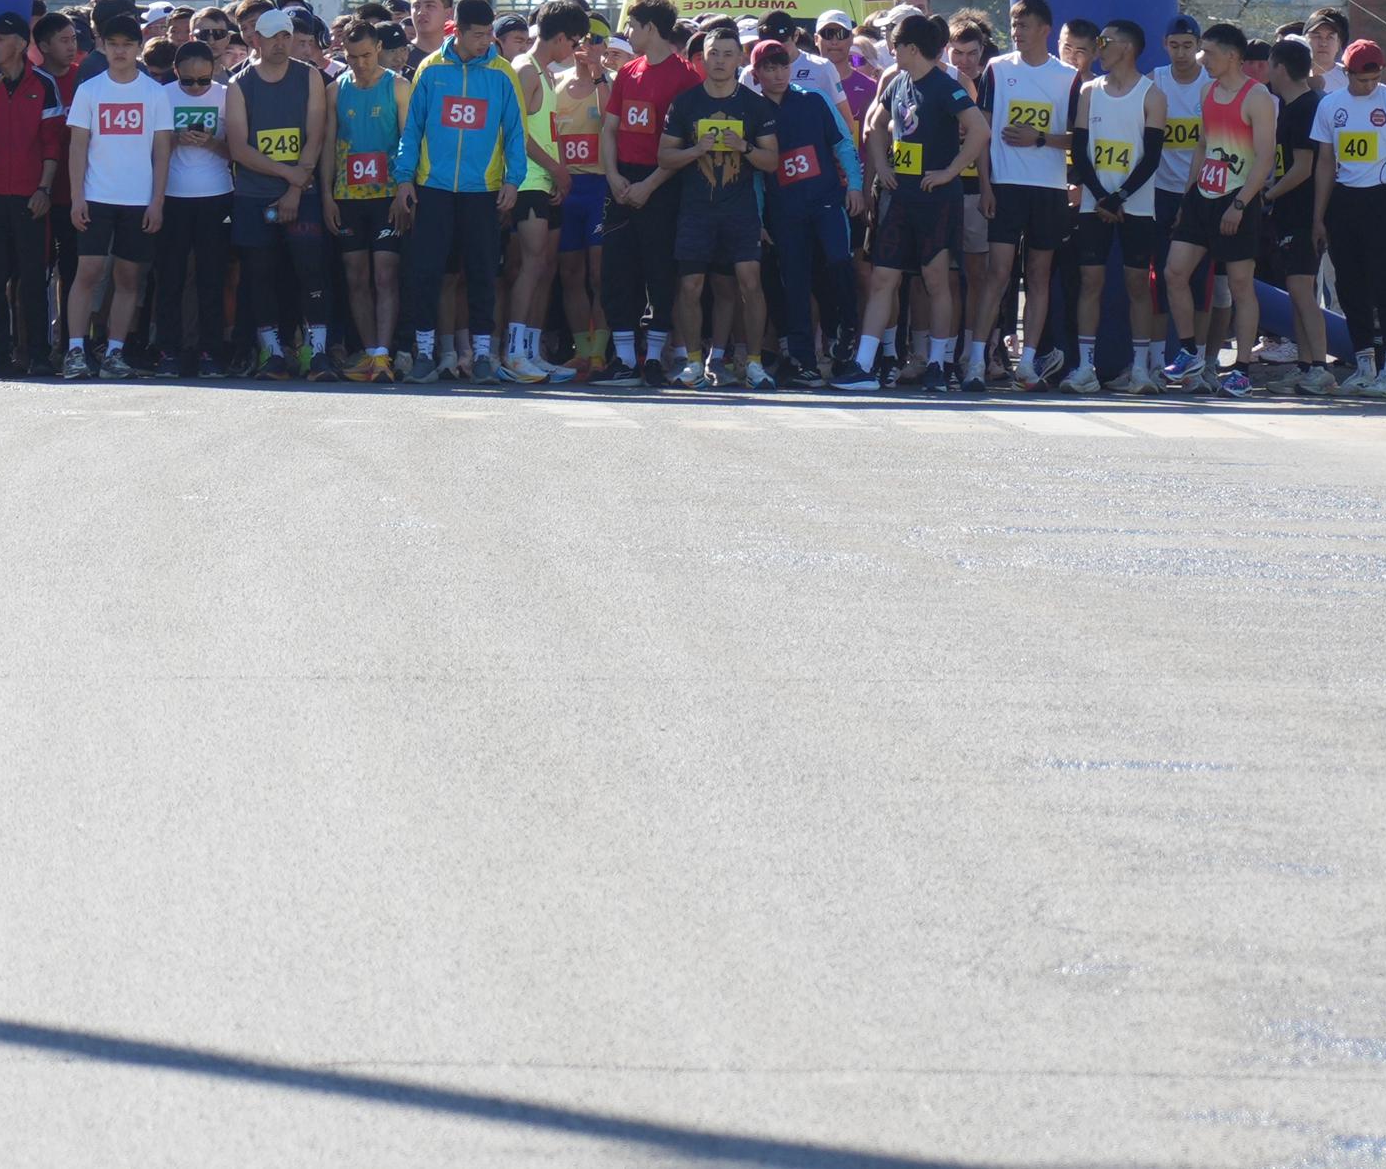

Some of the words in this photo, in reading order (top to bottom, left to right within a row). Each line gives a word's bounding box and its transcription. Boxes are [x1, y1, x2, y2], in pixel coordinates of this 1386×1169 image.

[100, 109, 141, 129] 149
[175, 111, 217, 129] 278
[449, 103, 476, 124] 58
[627, 106, 649, 127] 64
[1009, 106, 1051, 128] 229
[1163, 123, 1200, 144] 204
[260, 134, 299, 155] 248
[565, 140, 590, 160] 86
[1344, 138, 1368, 157] 40
[784, 154, 810, 177] 53
[1094, 145, 1129, 168] 214
[352, 159, 378, 179] 94
[1201, 163, 1224, 187] 141
